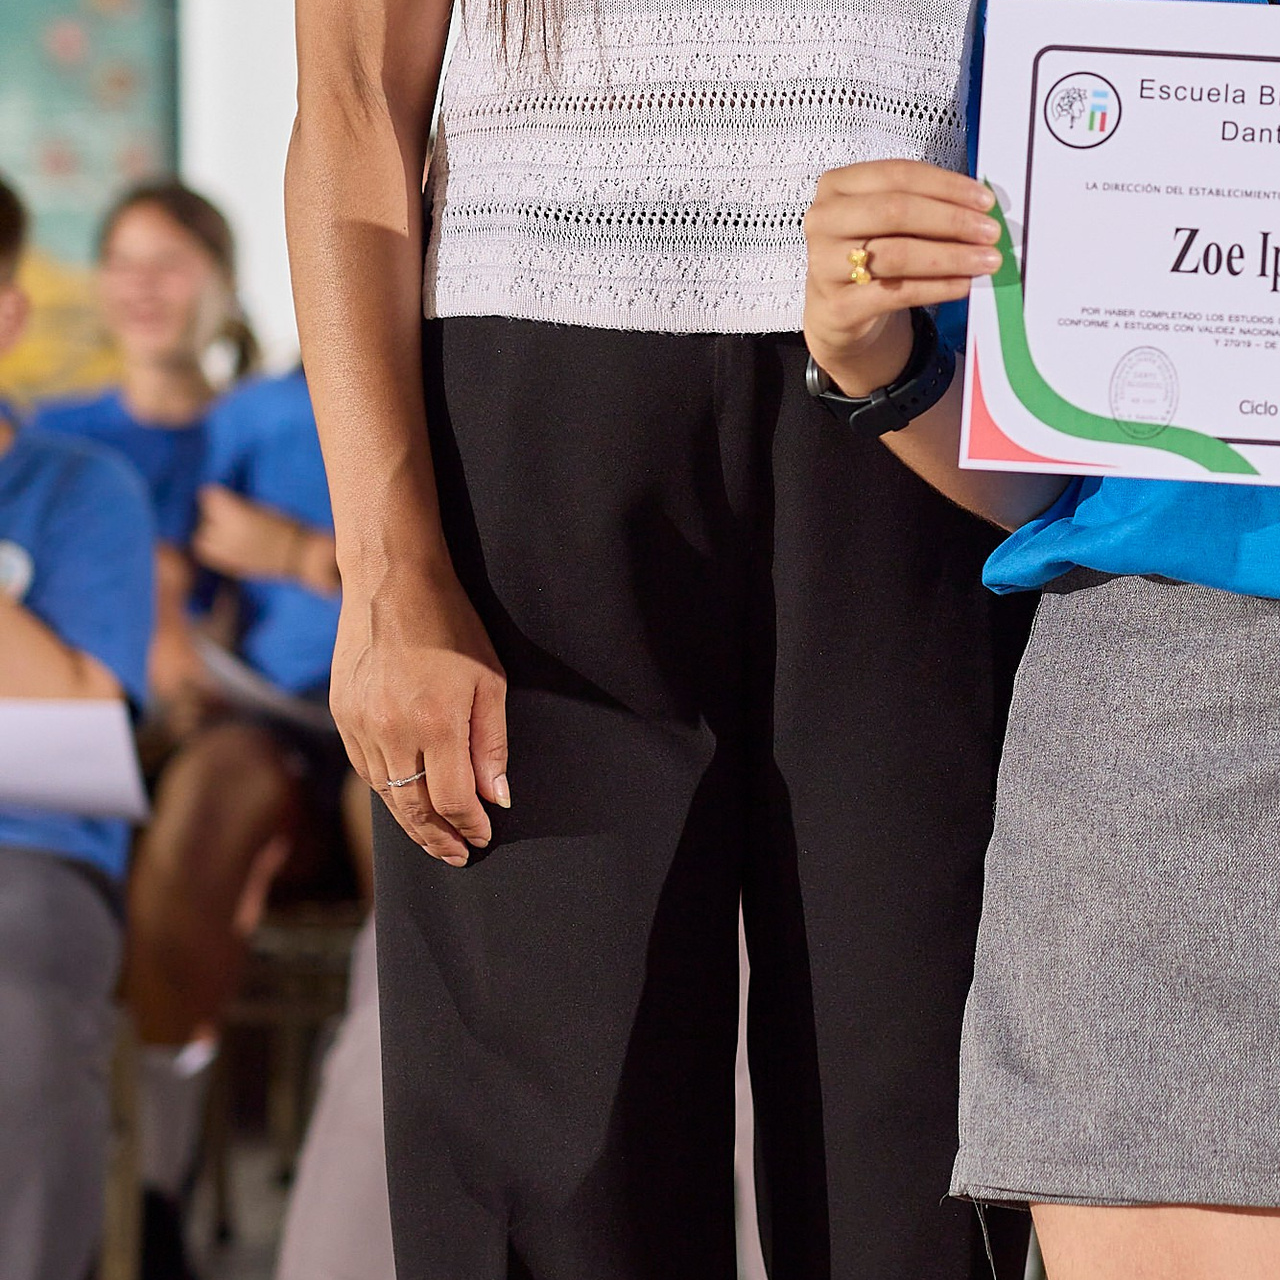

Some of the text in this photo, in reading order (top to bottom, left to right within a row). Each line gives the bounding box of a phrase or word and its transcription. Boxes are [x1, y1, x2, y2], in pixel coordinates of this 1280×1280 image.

[1139, 78, 1245, 104] Escuela
[1085, 181, 1099, 191] LA
[1102, 182, 1161, 194] DIRECCIÓN
[1165, 185, 1184, 196] DEL
[1170, 227, 1245, 277] Zoe
[1081, 306, 1101, 316] POR
[1104, 308, 1136, 318] HABER
[1139, 309, 1203, 322] COMPLETADO
[1205, 313, 1225, 322] LOS
[1228, 314, 1275, 325] ESTUDIOS
[1057, 317, 1109, 329] CONFORME
[1123, 320, 1170, 332] ESTUDIOS
[1173, 323, 1195, 333] CON
[1197, 325, 1236, 335] VALIDEZ
[1214, 338, 1220, 346] Y
[1264, 340, 1277, 350] DE
[1239, 400, 1278, 416] Ciclo
